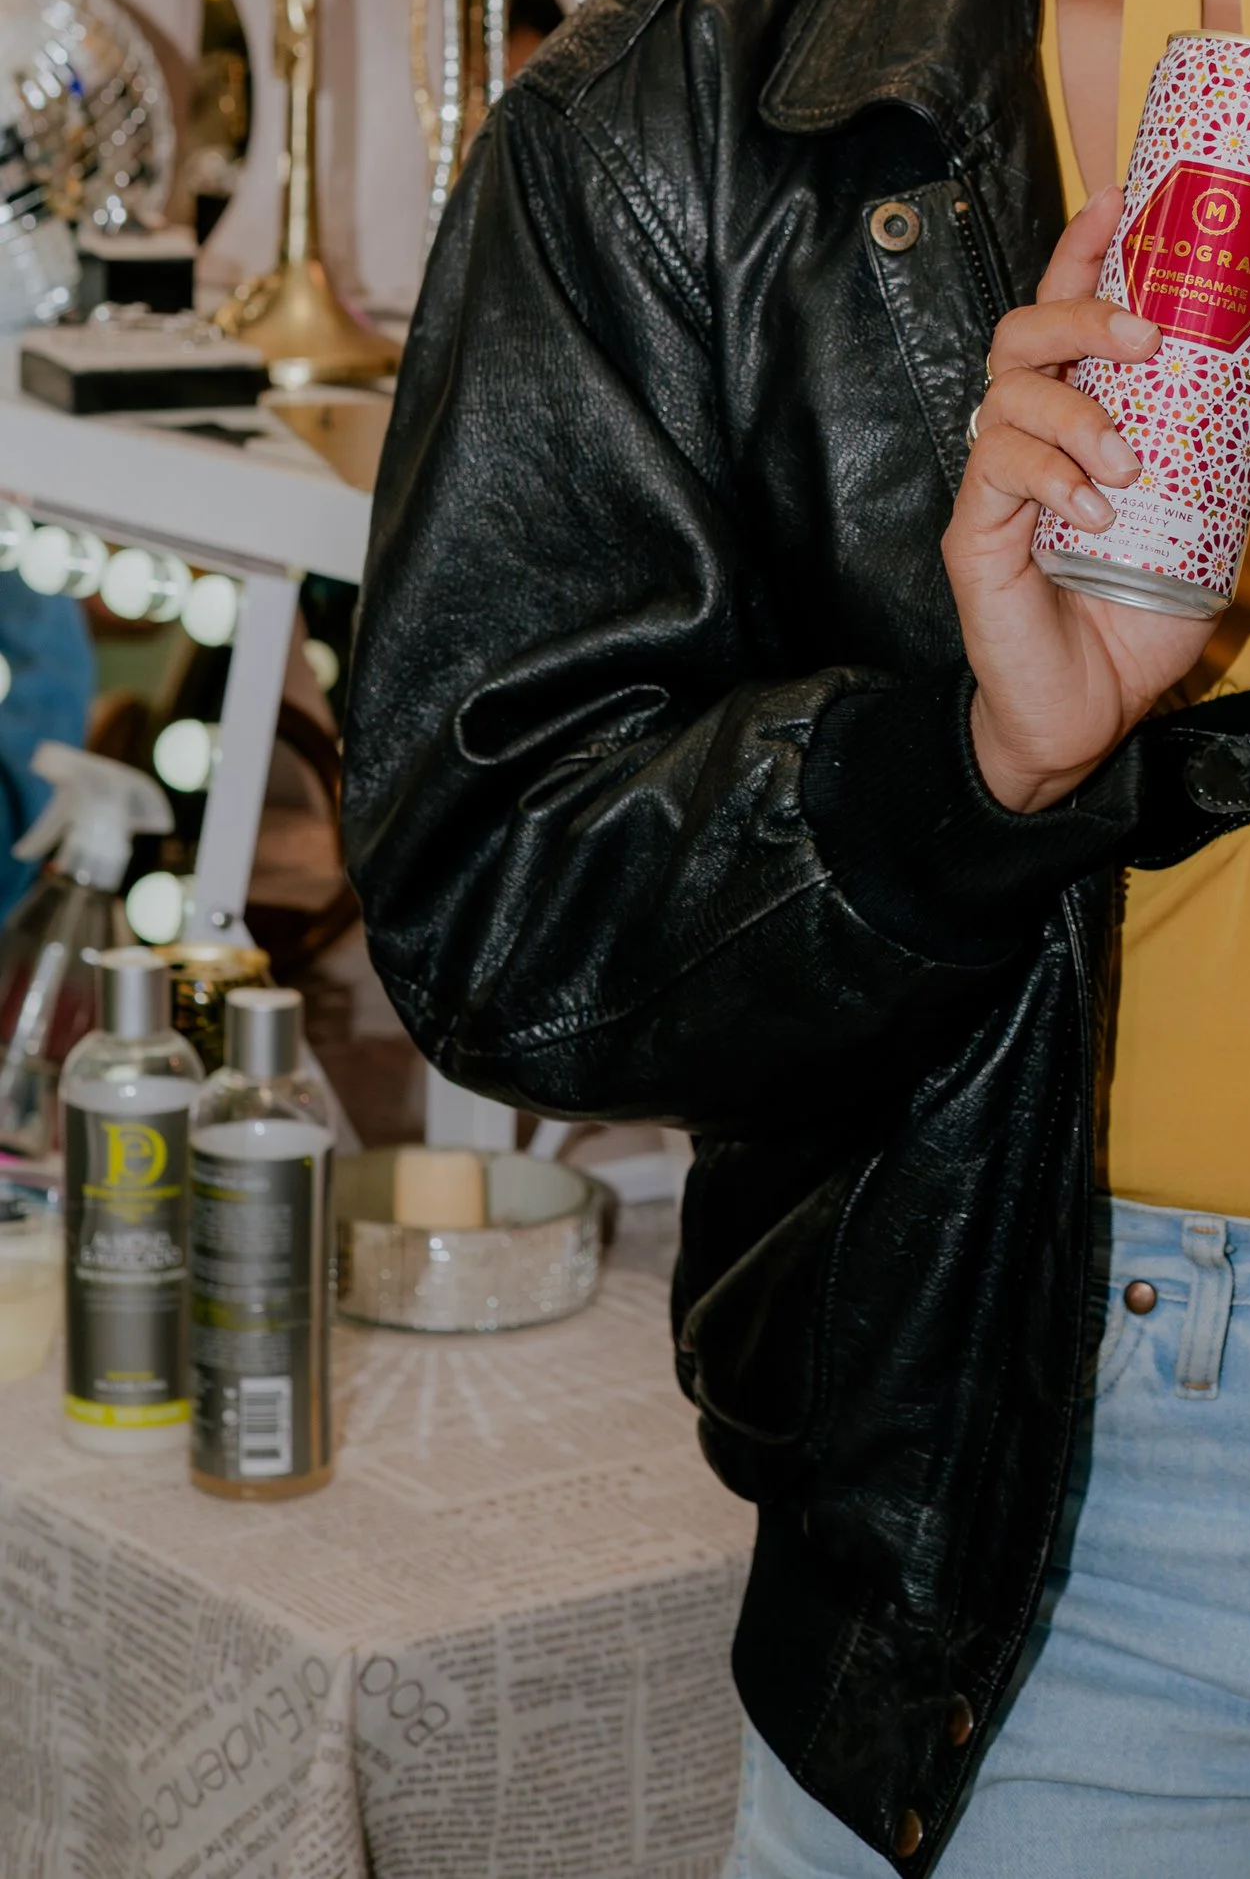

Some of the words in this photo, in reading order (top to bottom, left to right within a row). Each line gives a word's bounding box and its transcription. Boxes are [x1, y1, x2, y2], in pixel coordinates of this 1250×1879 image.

[1205, 201, 1228, 223] M
[1148, 267, 1249, 301] POMEGRANATE
[1142, 281, 1248, 315] COSMOPOLITAN
[1114, 507, 1170, 529] PECIALTY
[1120, 497, 1161, 513] AGAVE
[1164, 506, 1194, 523] WINE
